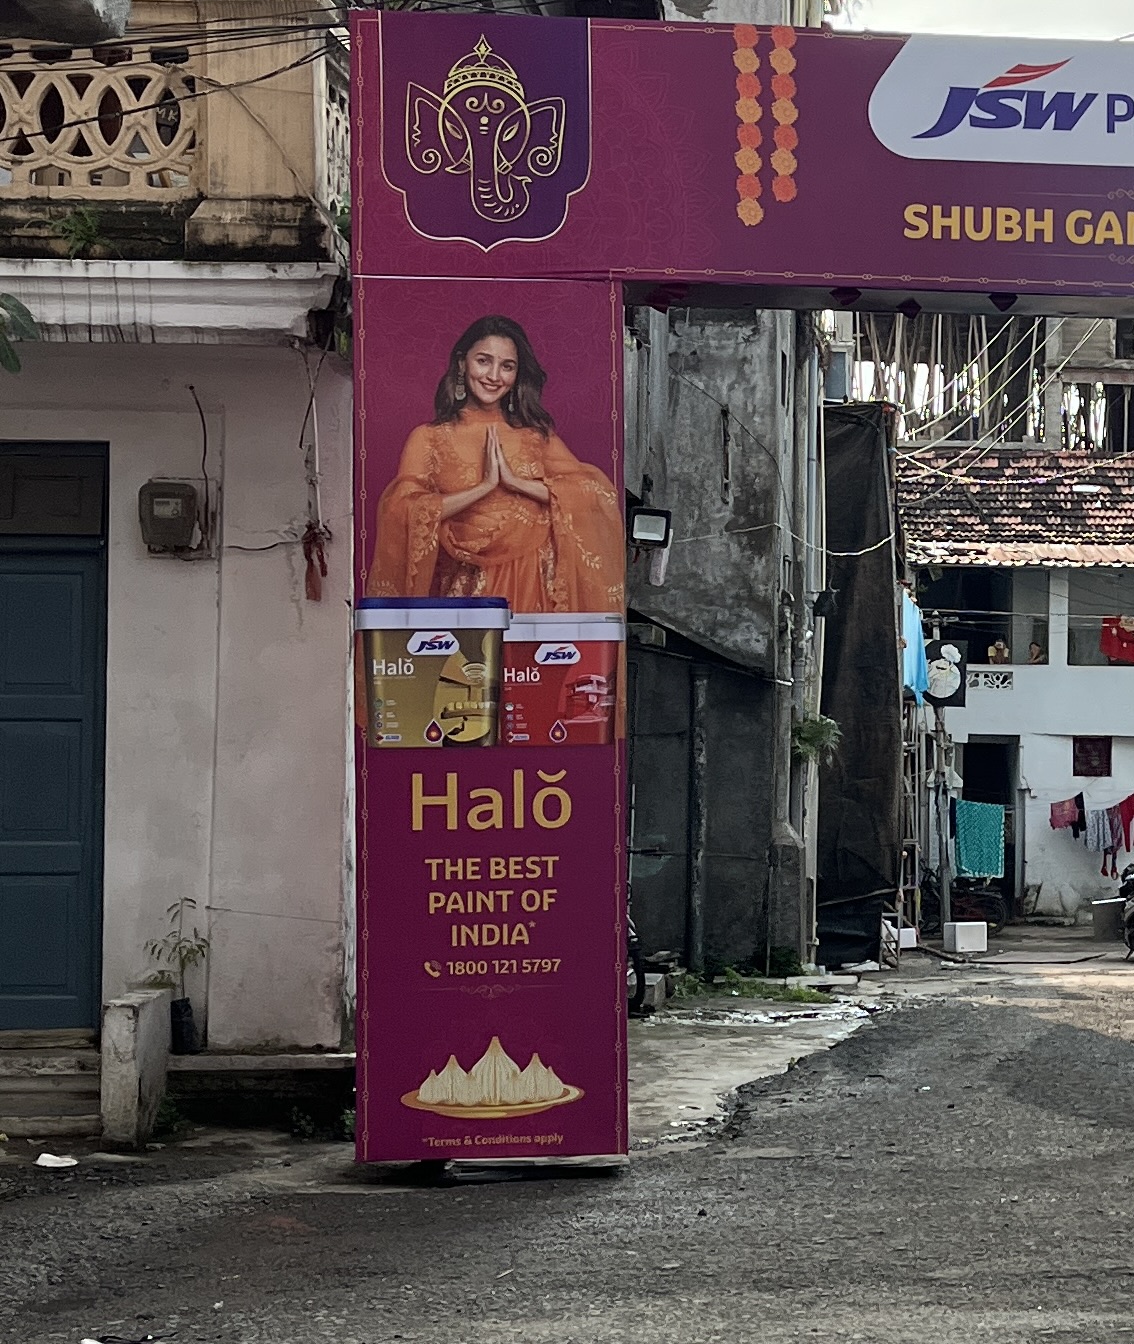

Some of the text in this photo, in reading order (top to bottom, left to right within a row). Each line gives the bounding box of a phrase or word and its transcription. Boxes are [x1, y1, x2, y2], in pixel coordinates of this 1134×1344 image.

[910, 86, 1098, 139] JSW
[903, 203, 1053, 243] SHUBH
[414, 640, 456, 653] JSW
[541, 651, 577, 663] JSW
[424, 856, 560, 881] THE BEST
[428, 889, 557, 914] PAINT OF
[446, 958, 561, 975] 1800 121 5797
[464, 1136, 472, 1146] &
[474, 1134, 532, 1145] Conditions
[533, 1133, 563, 1145] apply
